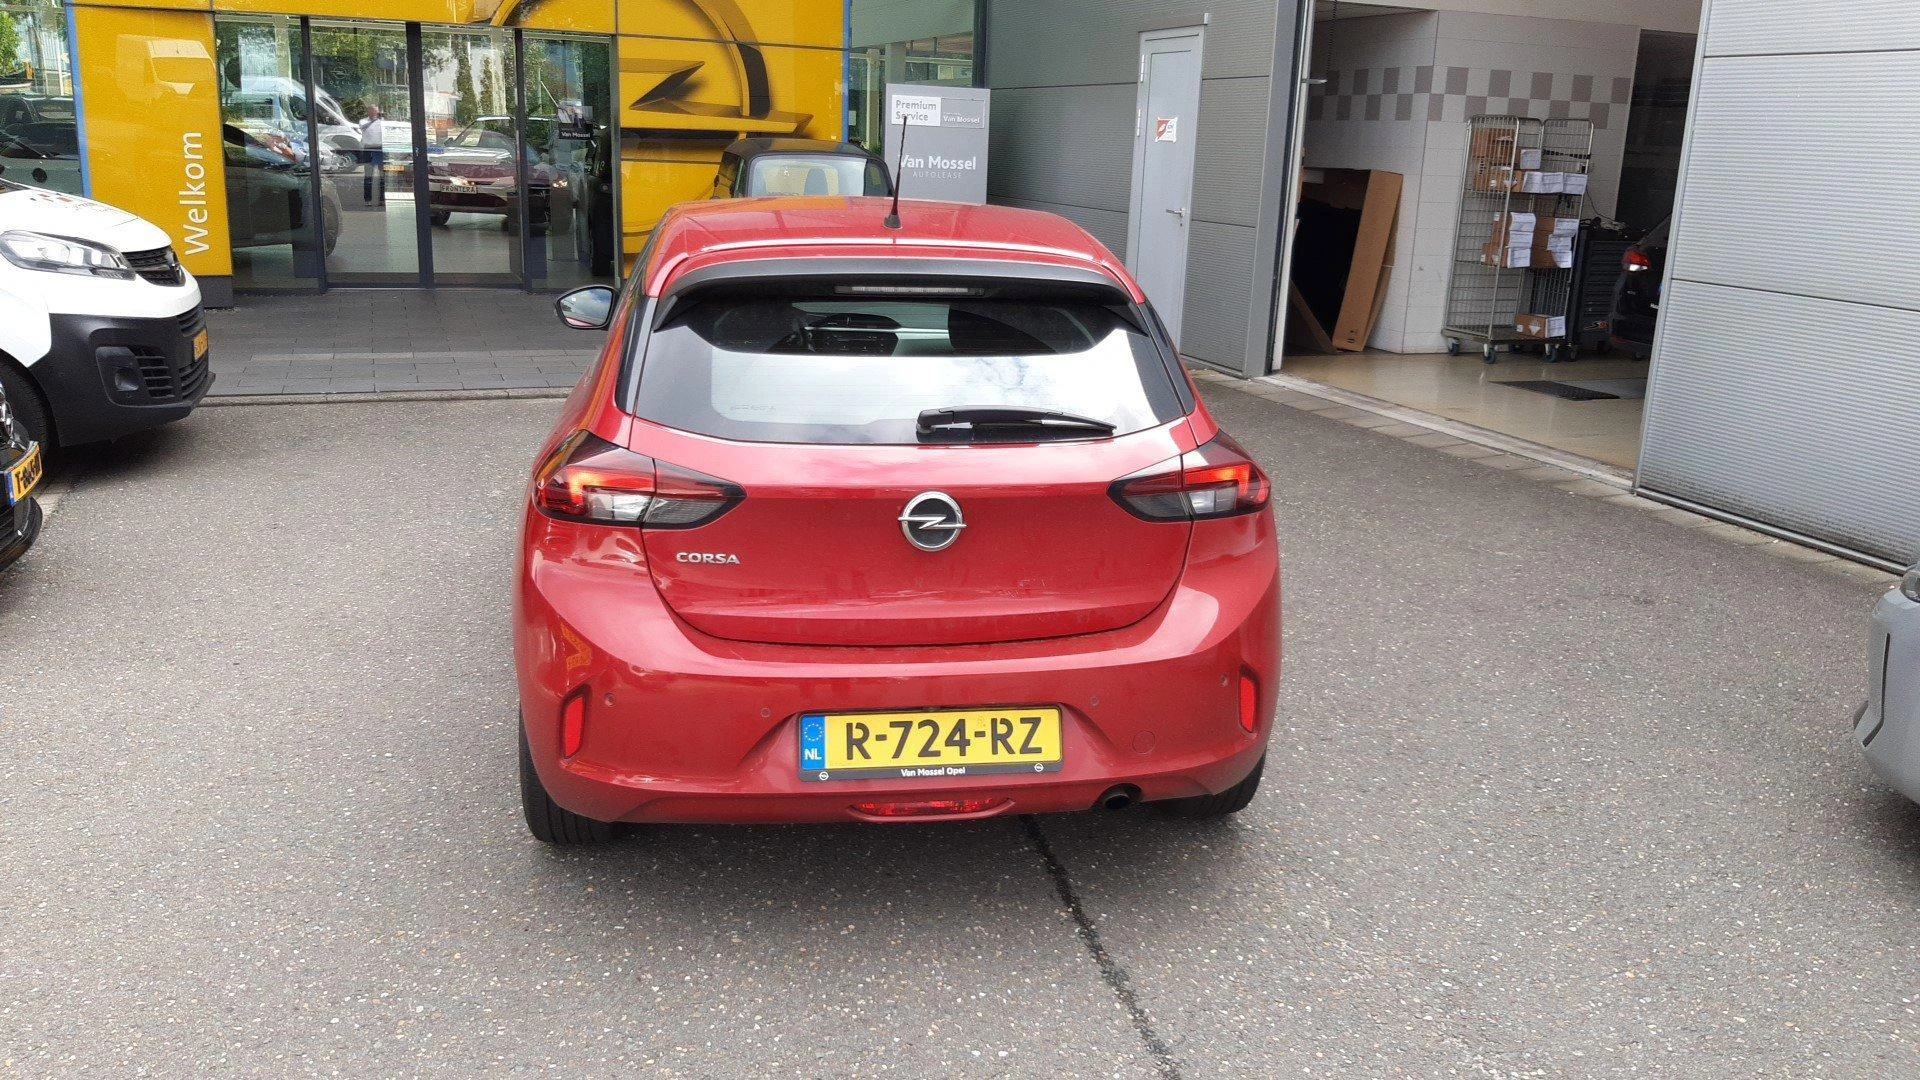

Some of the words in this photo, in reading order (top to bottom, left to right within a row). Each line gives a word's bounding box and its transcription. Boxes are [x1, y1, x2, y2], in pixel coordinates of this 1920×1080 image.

[895, 99, 937, 111] Premium
[895, 111, 929, 121] Service
[957, 116, 980, 124] Mossel
[898, 154, 924, 168] Van
[928, 155, 977, 170] Mossel
[912, 171, 962, 179] AUTOLEASE
[179, 132, 210, 256] Welkom
[441, 185, 476, 193] FRONTERA
[676, 552, 740, 564] CORSA
[846, 716, 1043, 761] R-724-RZ
[804, 749, 822, 760] NL
[901, 768, 916, 777] Van
[917, 767, 945, 776] Mossel
[946, 766, 966, 776] Opel
